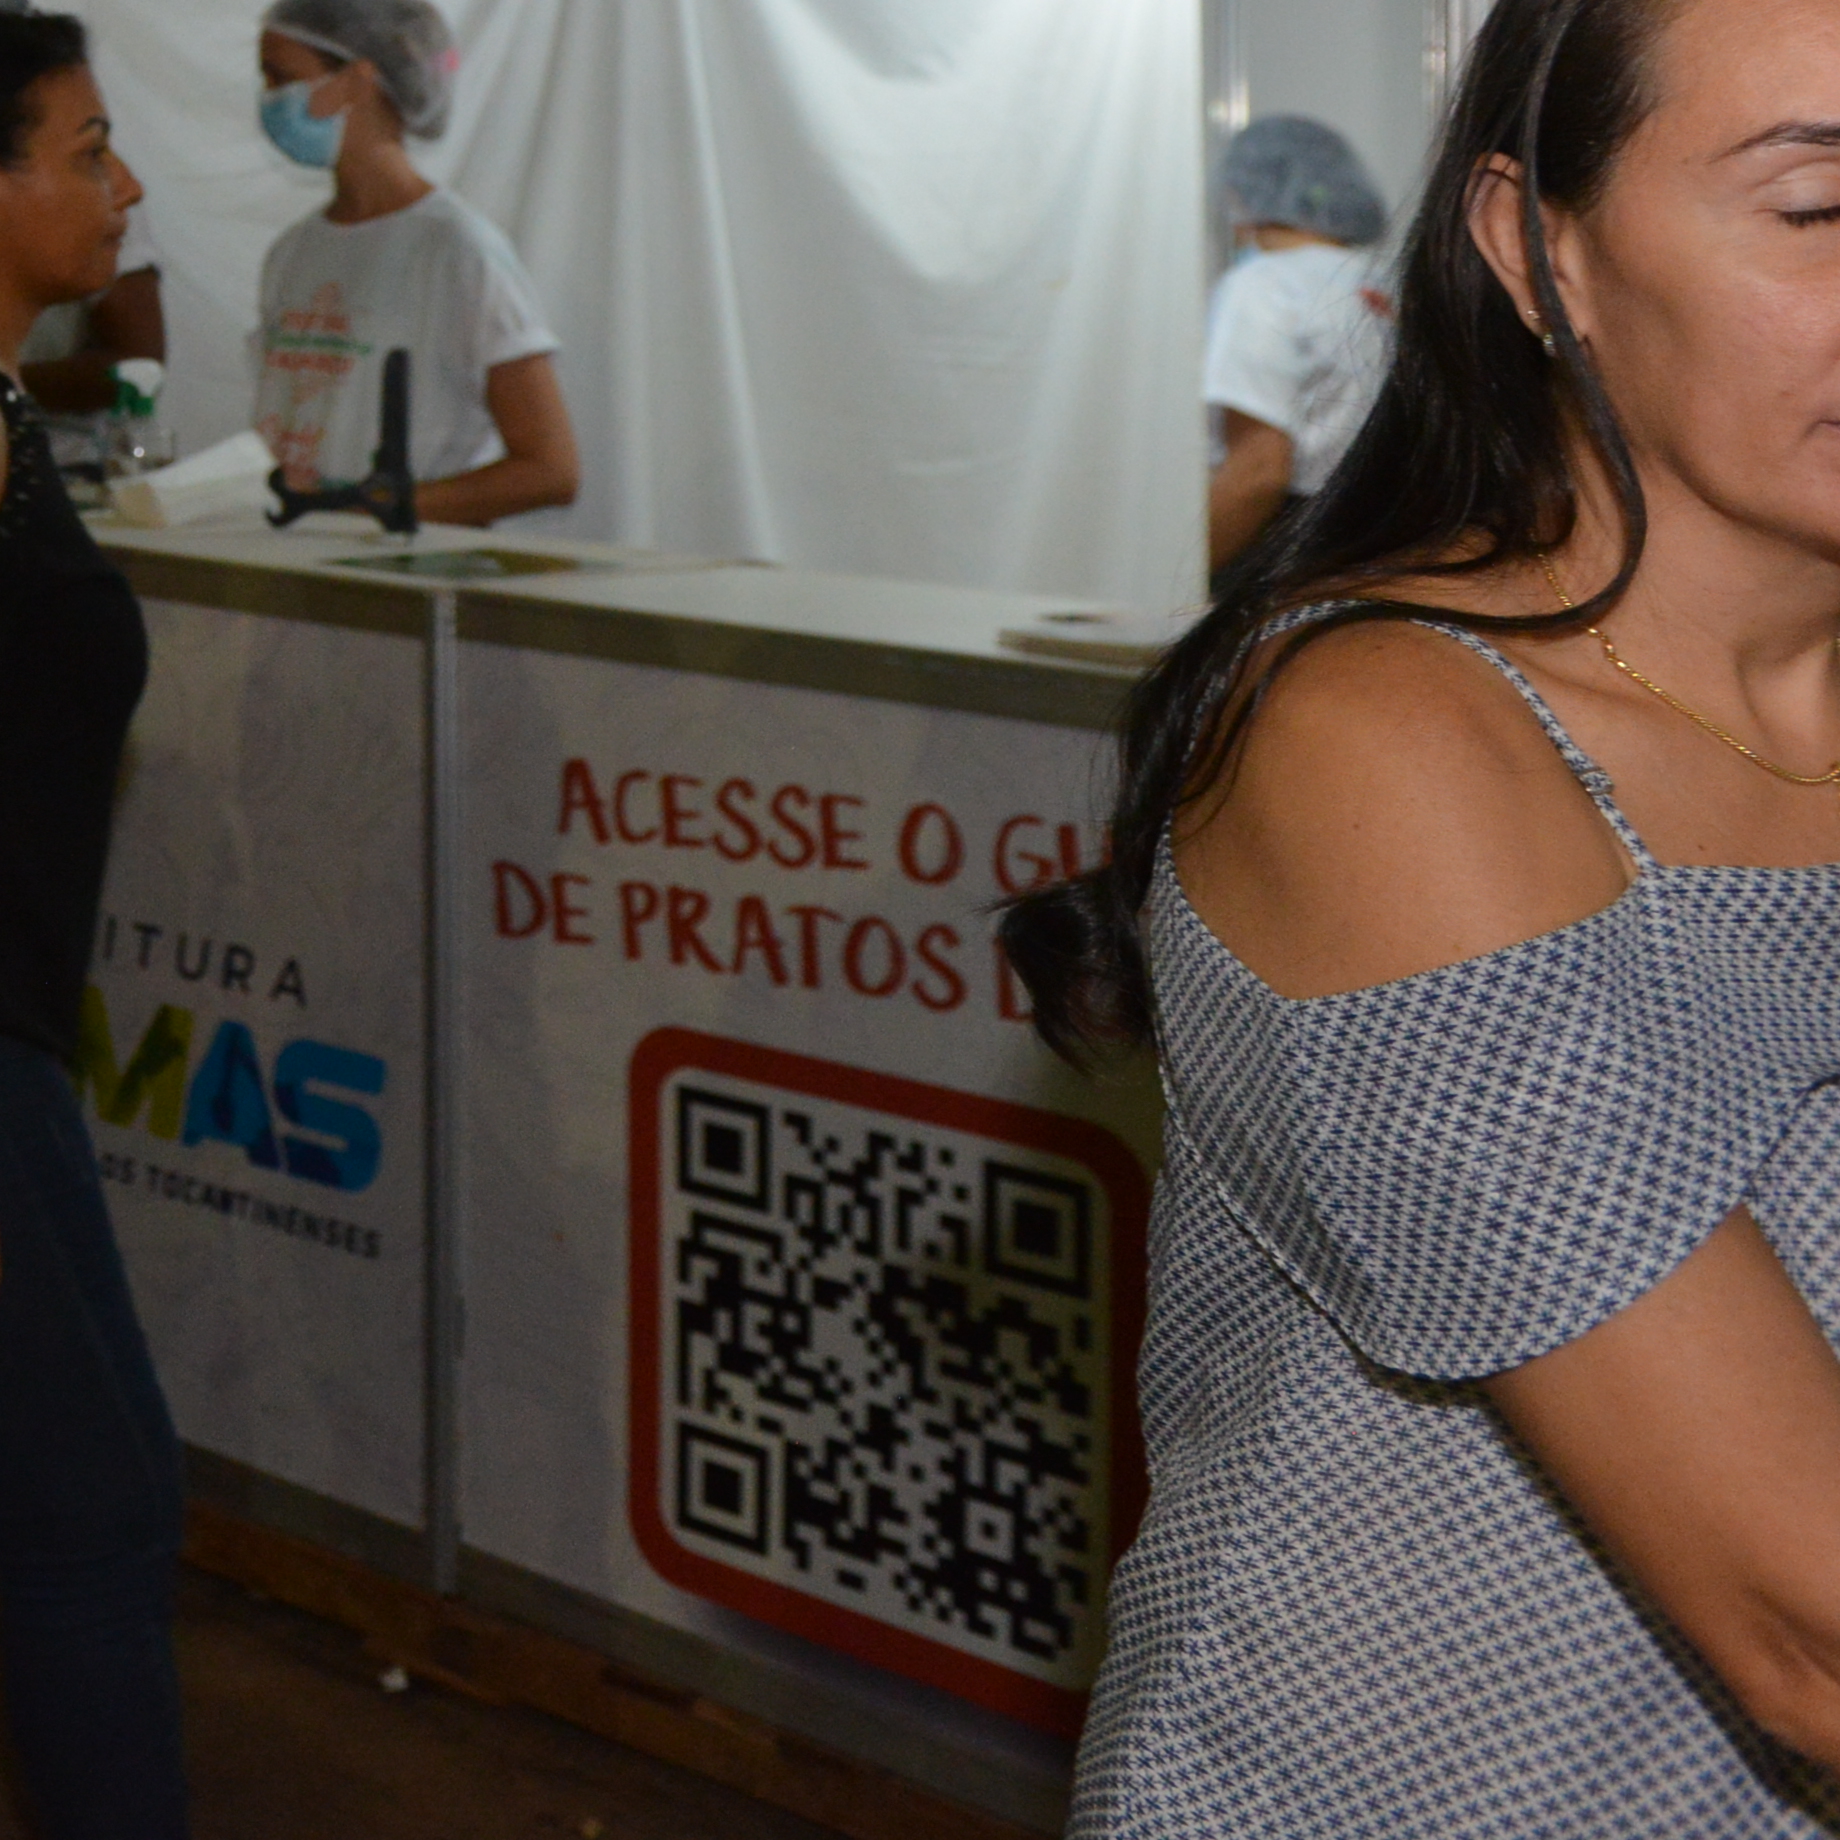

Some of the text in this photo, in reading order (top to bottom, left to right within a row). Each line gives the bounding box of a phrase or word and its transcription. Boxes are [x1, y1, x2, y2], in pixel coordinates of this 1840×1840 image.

[557, 757, 870, 870] ACESSE
[898, 802, 964, 886] O
[100, 916, 308, 1009] ITURA
[492, 859, 594, 946] DE
[618, 879, 968, 1013] PRATOS
[72, 982, 387, 1194] MAS
[146, 1162, 384, 1260] TOCANTINENSES
